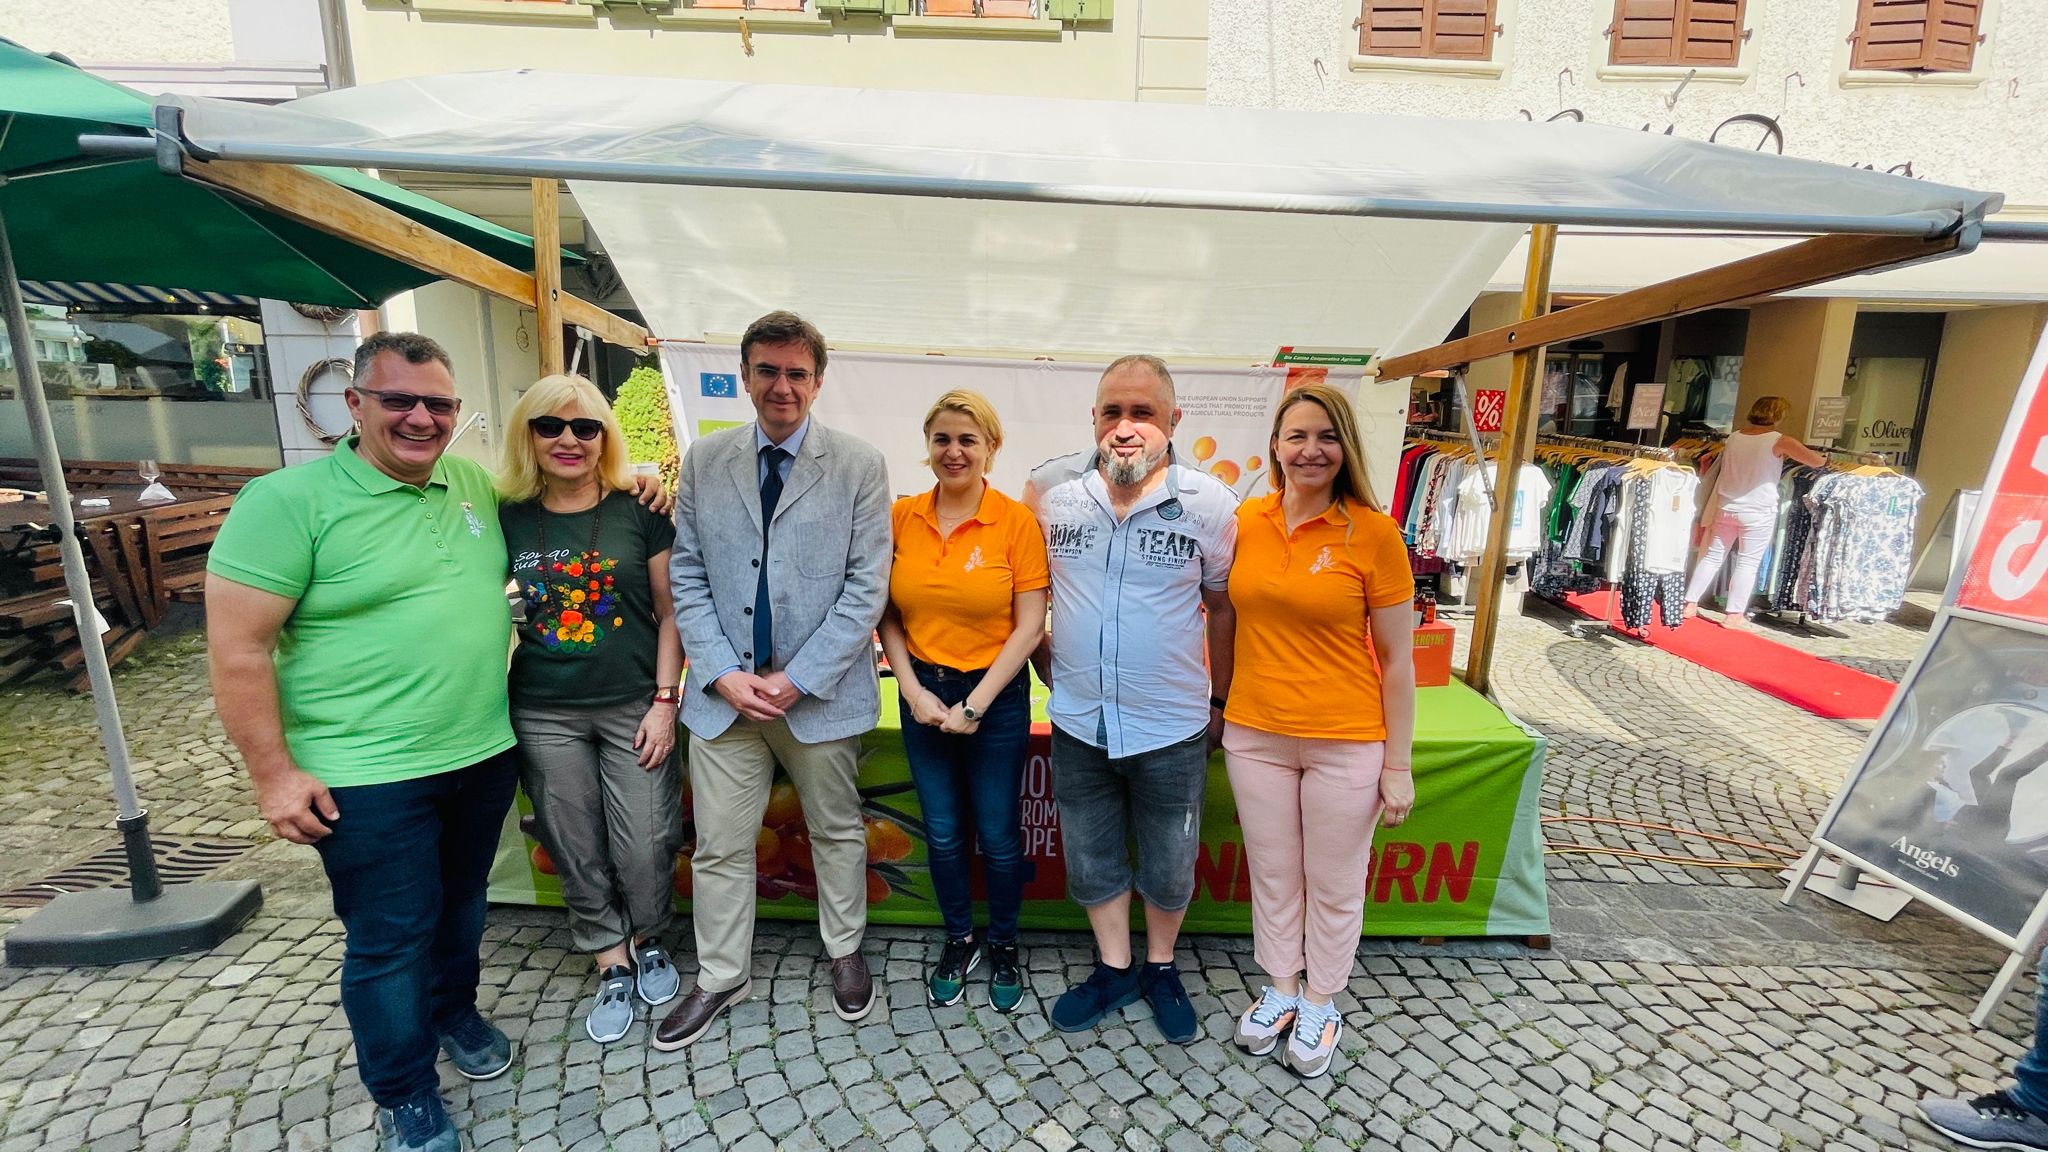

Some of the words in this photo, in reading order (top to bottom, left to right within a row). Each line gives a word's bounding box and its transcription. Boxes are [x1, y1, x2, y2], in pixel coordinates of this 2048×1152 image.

[1137, 528, 1198, 559] TEAM
[1141, 554, 1165, 562] STRONG
[1019, 799, 1057, 826] ROM
[1889, 836, 1960, 877] Angels
